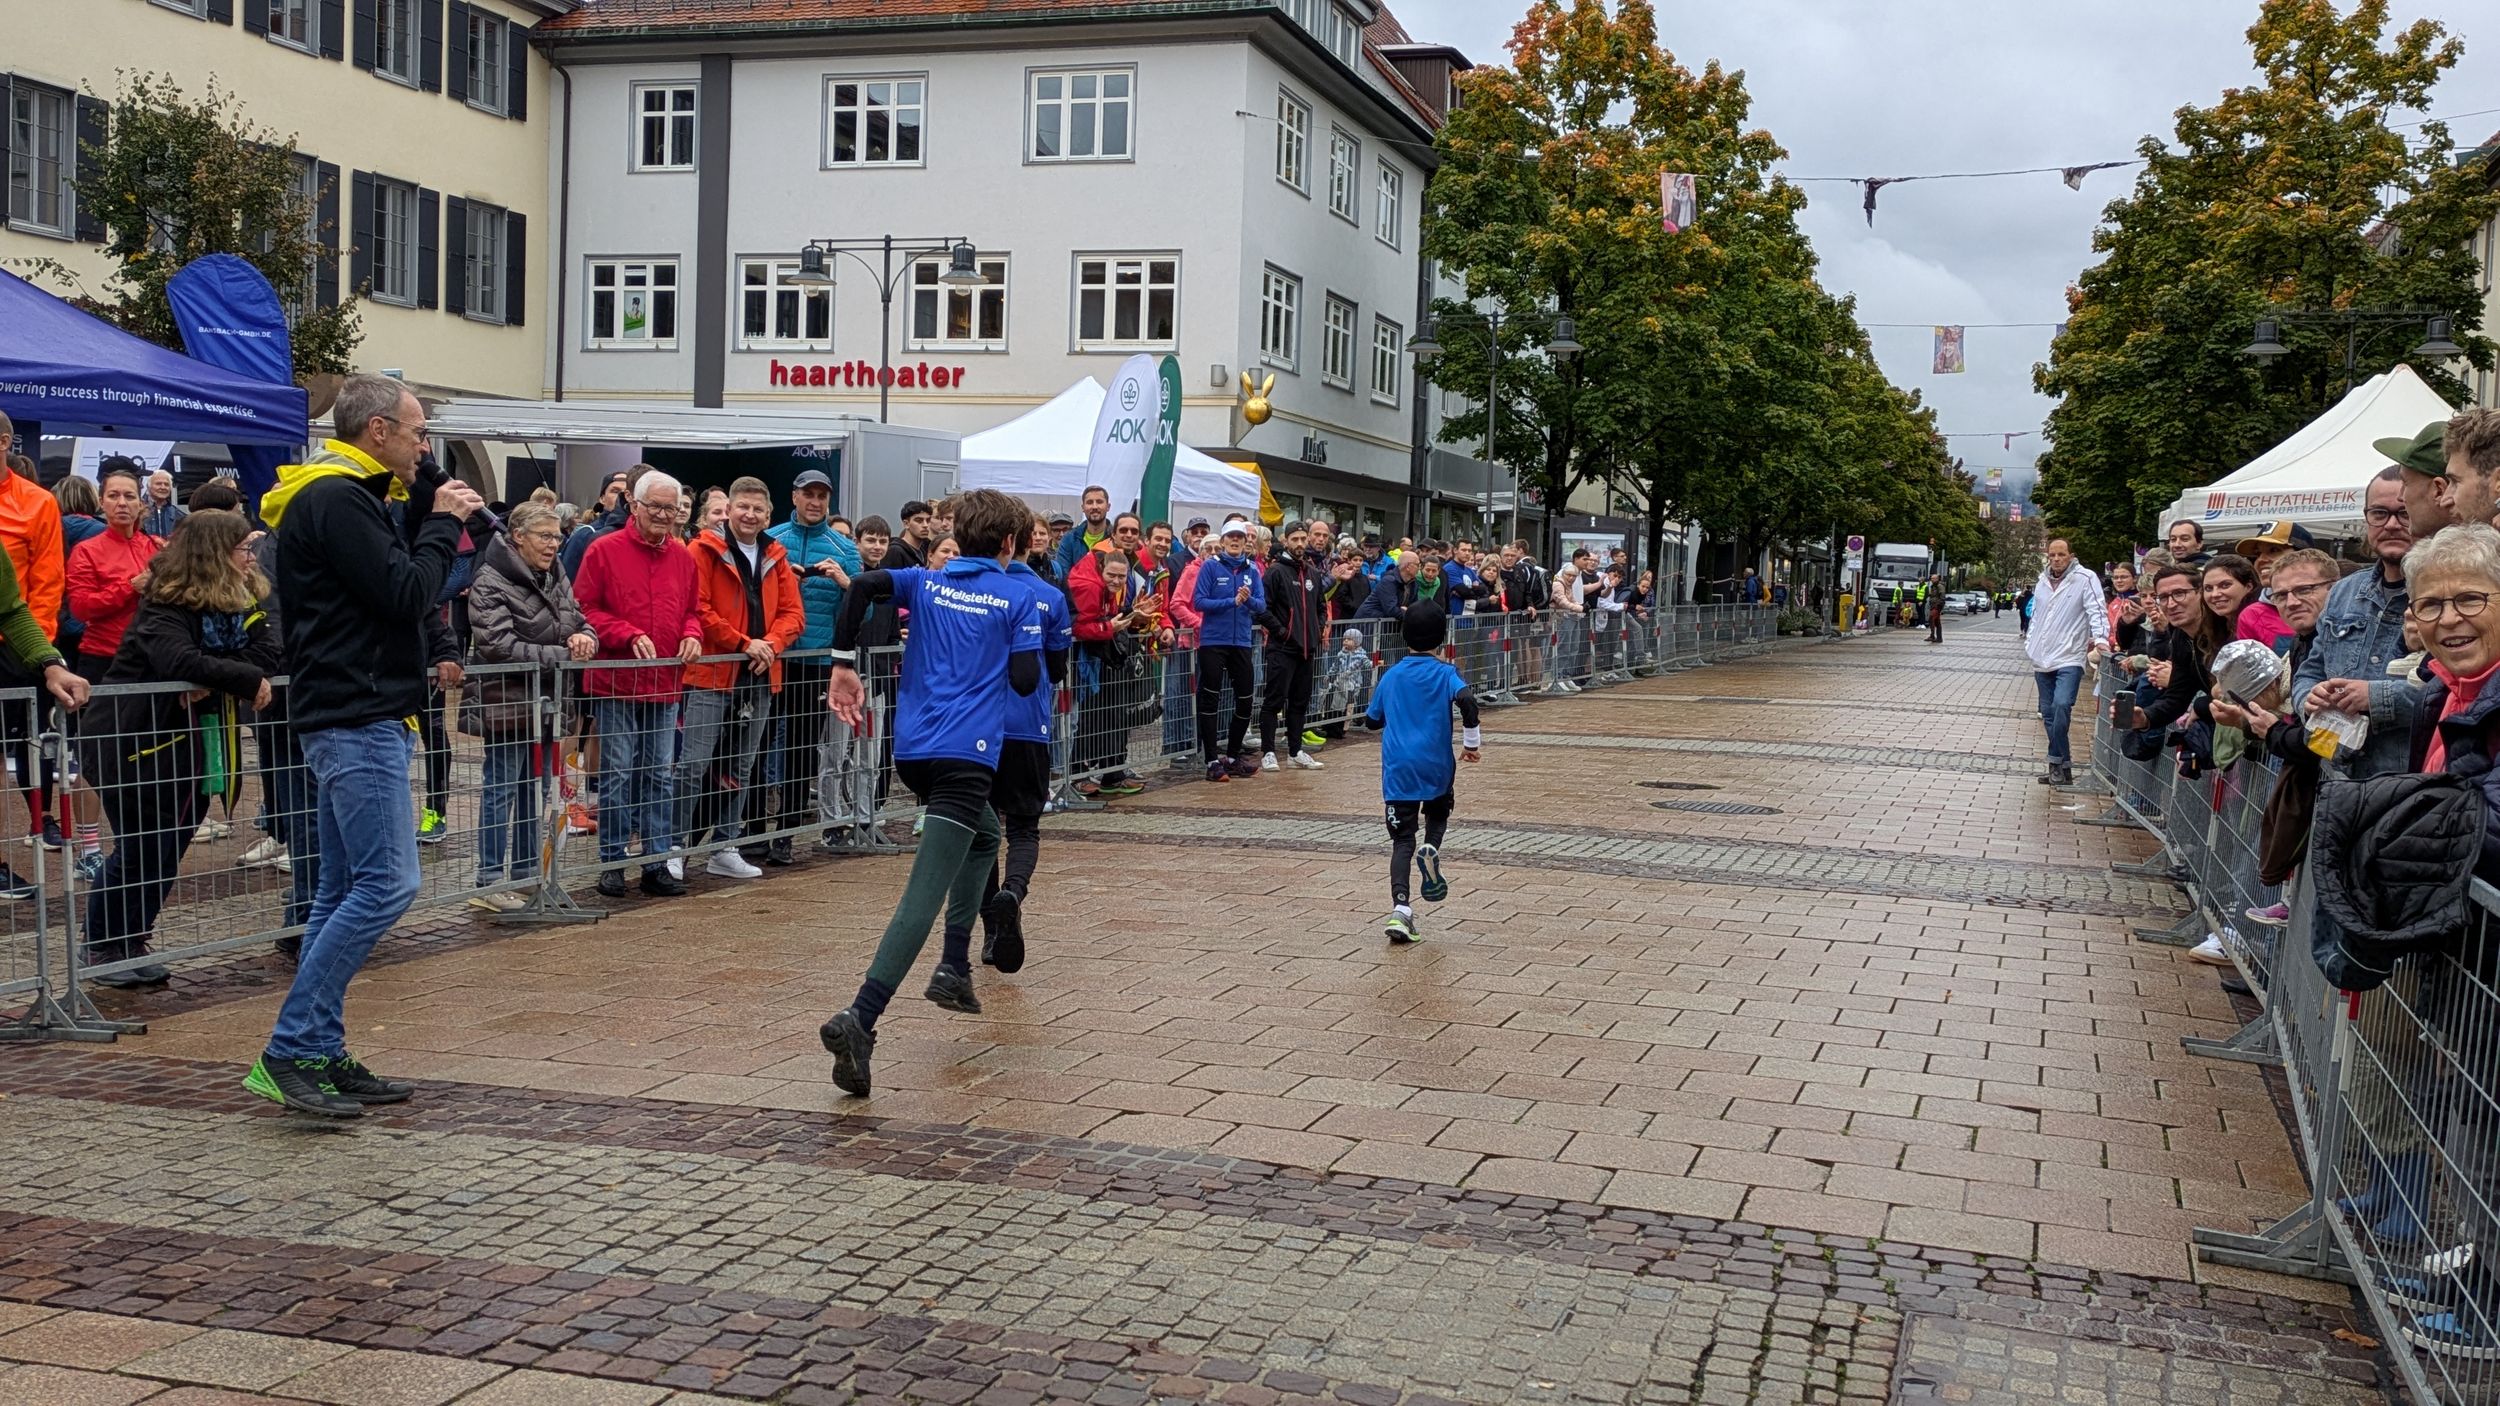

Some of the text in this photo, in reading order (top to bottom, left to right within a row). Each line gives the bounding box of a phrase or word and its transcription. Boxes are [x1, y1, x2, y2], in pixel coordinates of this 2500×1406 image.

[769, 358, 965, 389] haartheater
[50, 386, 99, 400] success
[102, 387, 151, 406] through
[154, 392, 203, 411] financial
[204, 402, 257, 418] expertise.
[1105, 418, 1146, 443] AOK
[791, 446, 818, 458] AOK
[2224, 502, 2357, 517] BADEN-WÜRTTEMBERG
[2226, 490, 2359, 509] LEICHTATHLETIK
[933, 596, 989, 615] Schwimmen
[940, 585, 1010, 609] Weilstetten
